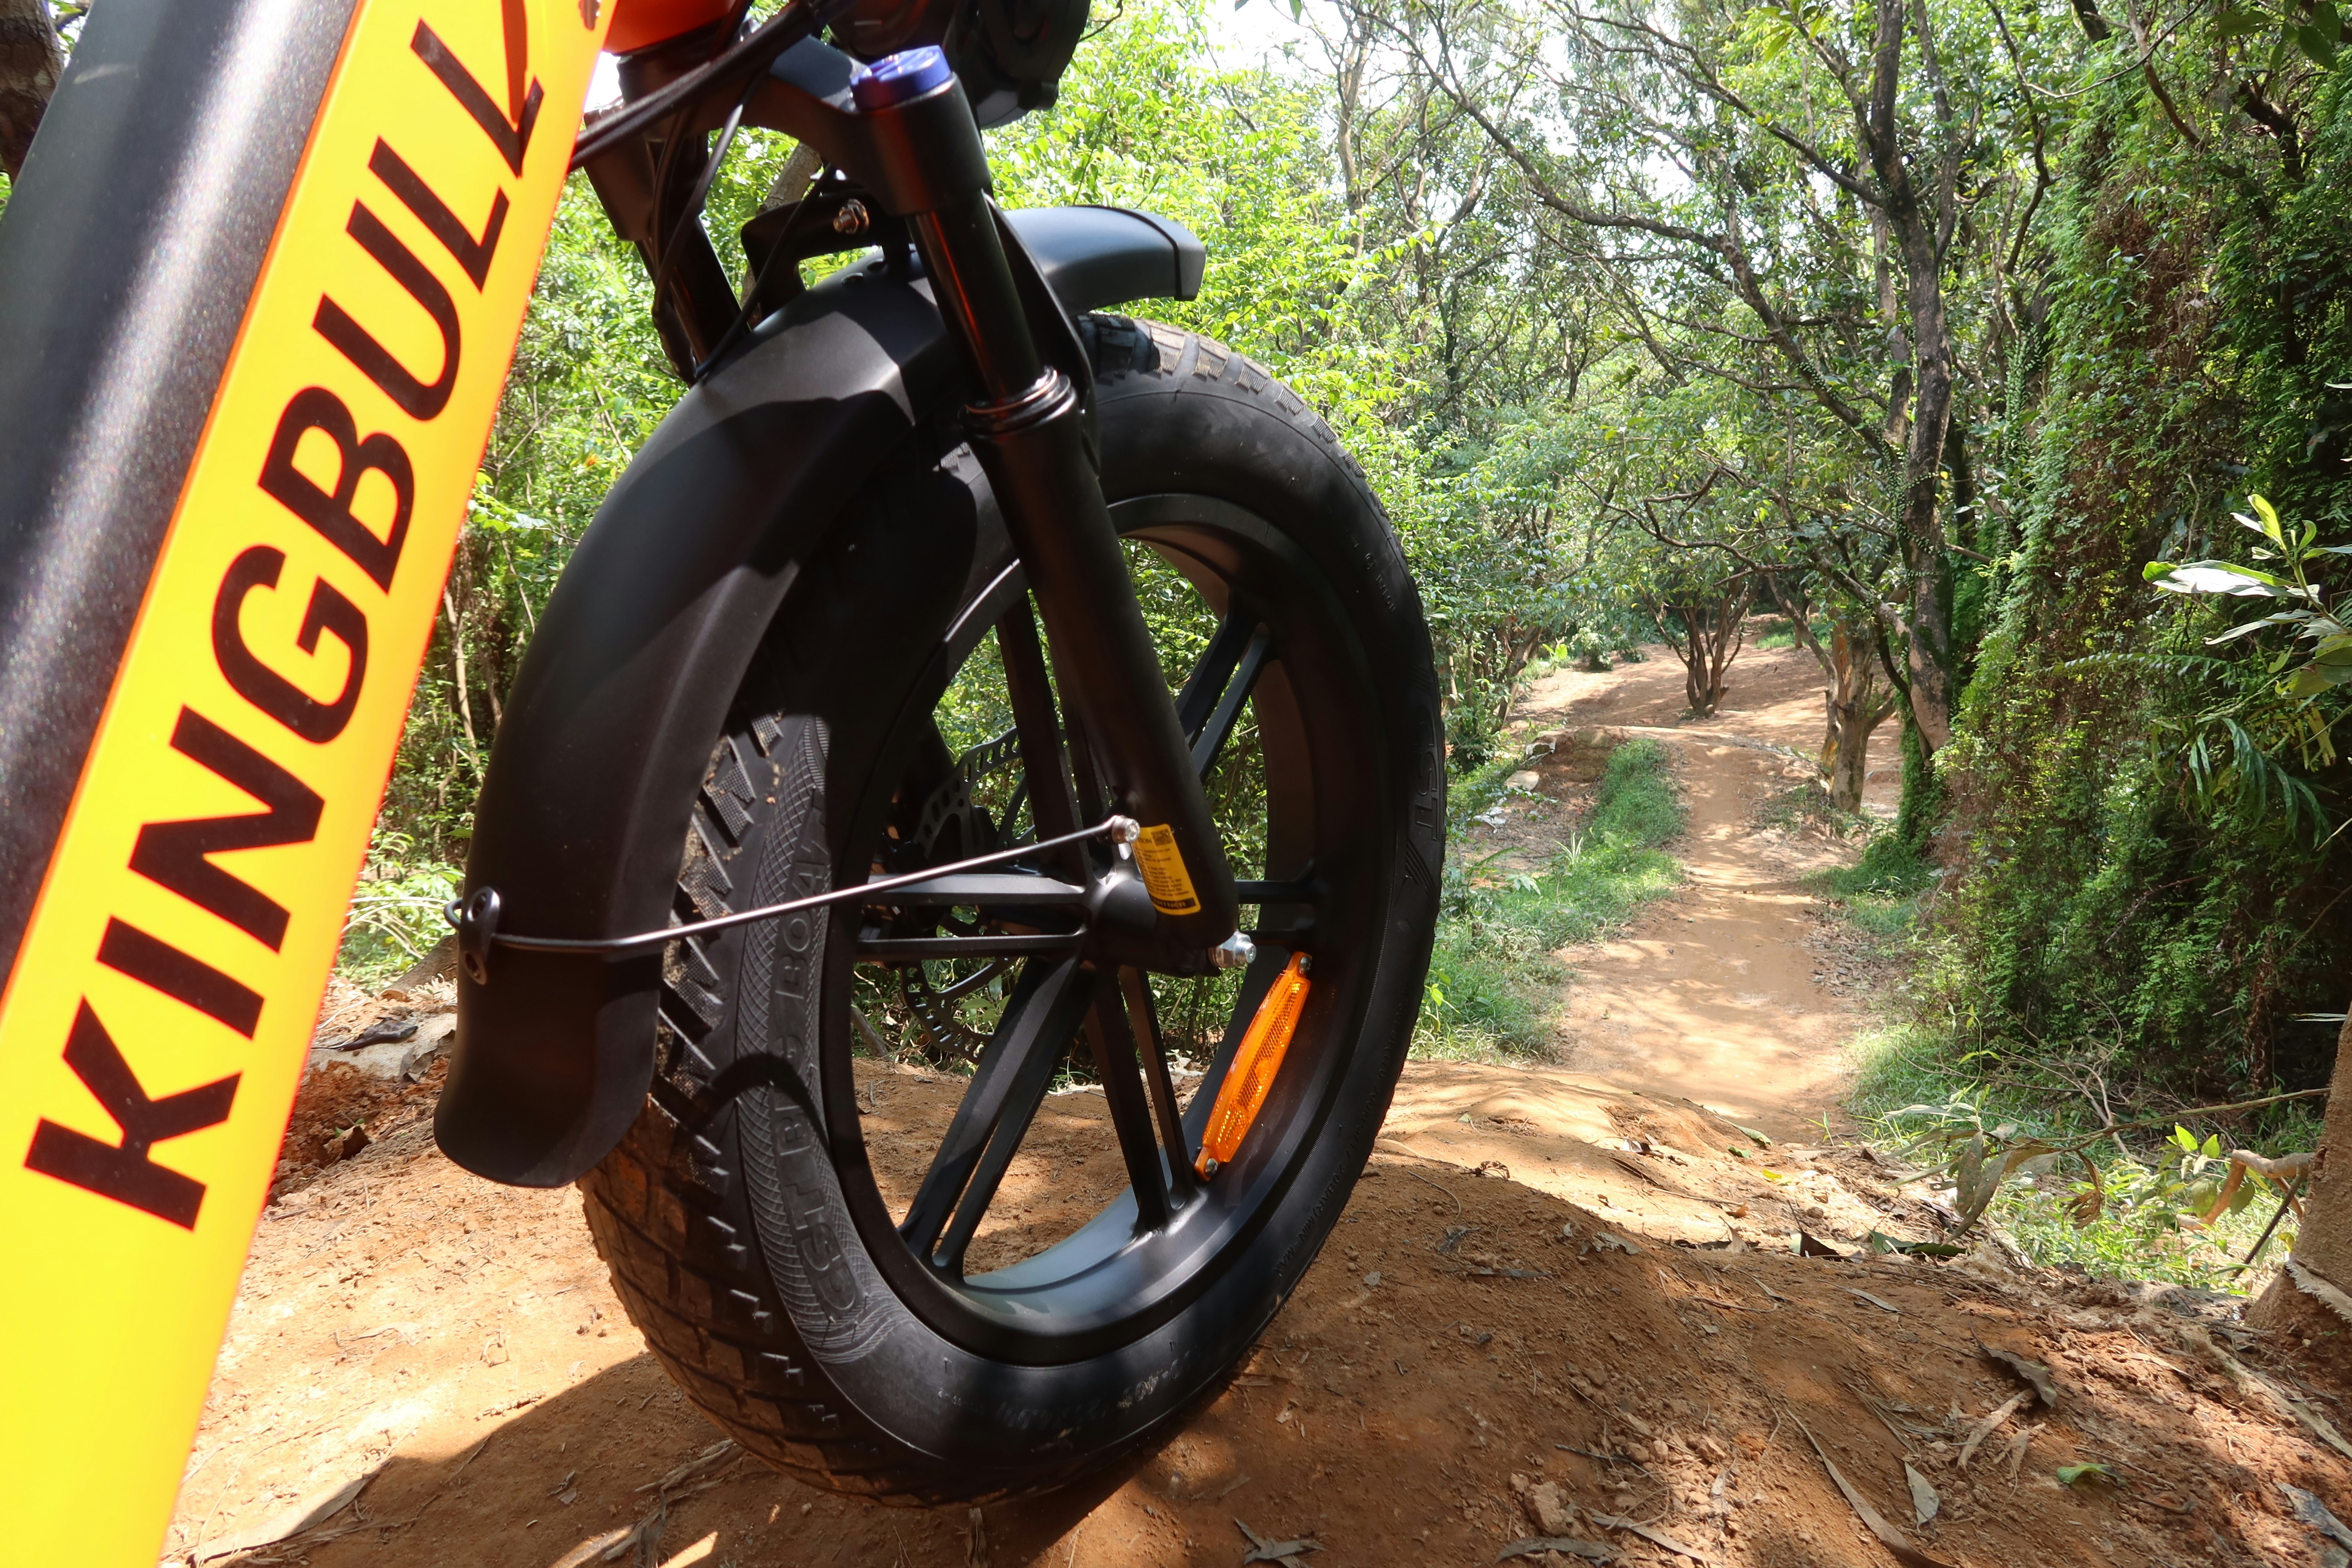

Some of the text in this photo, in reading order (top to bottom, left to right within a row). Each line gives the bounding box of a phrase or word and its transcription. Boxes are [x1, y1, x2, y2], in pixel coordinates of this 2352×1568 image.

[24, 17, 545, 1231] KINGBULL
[1410, 704, 1438, 841] CST
[784, 1182, 857, 1311] CST
